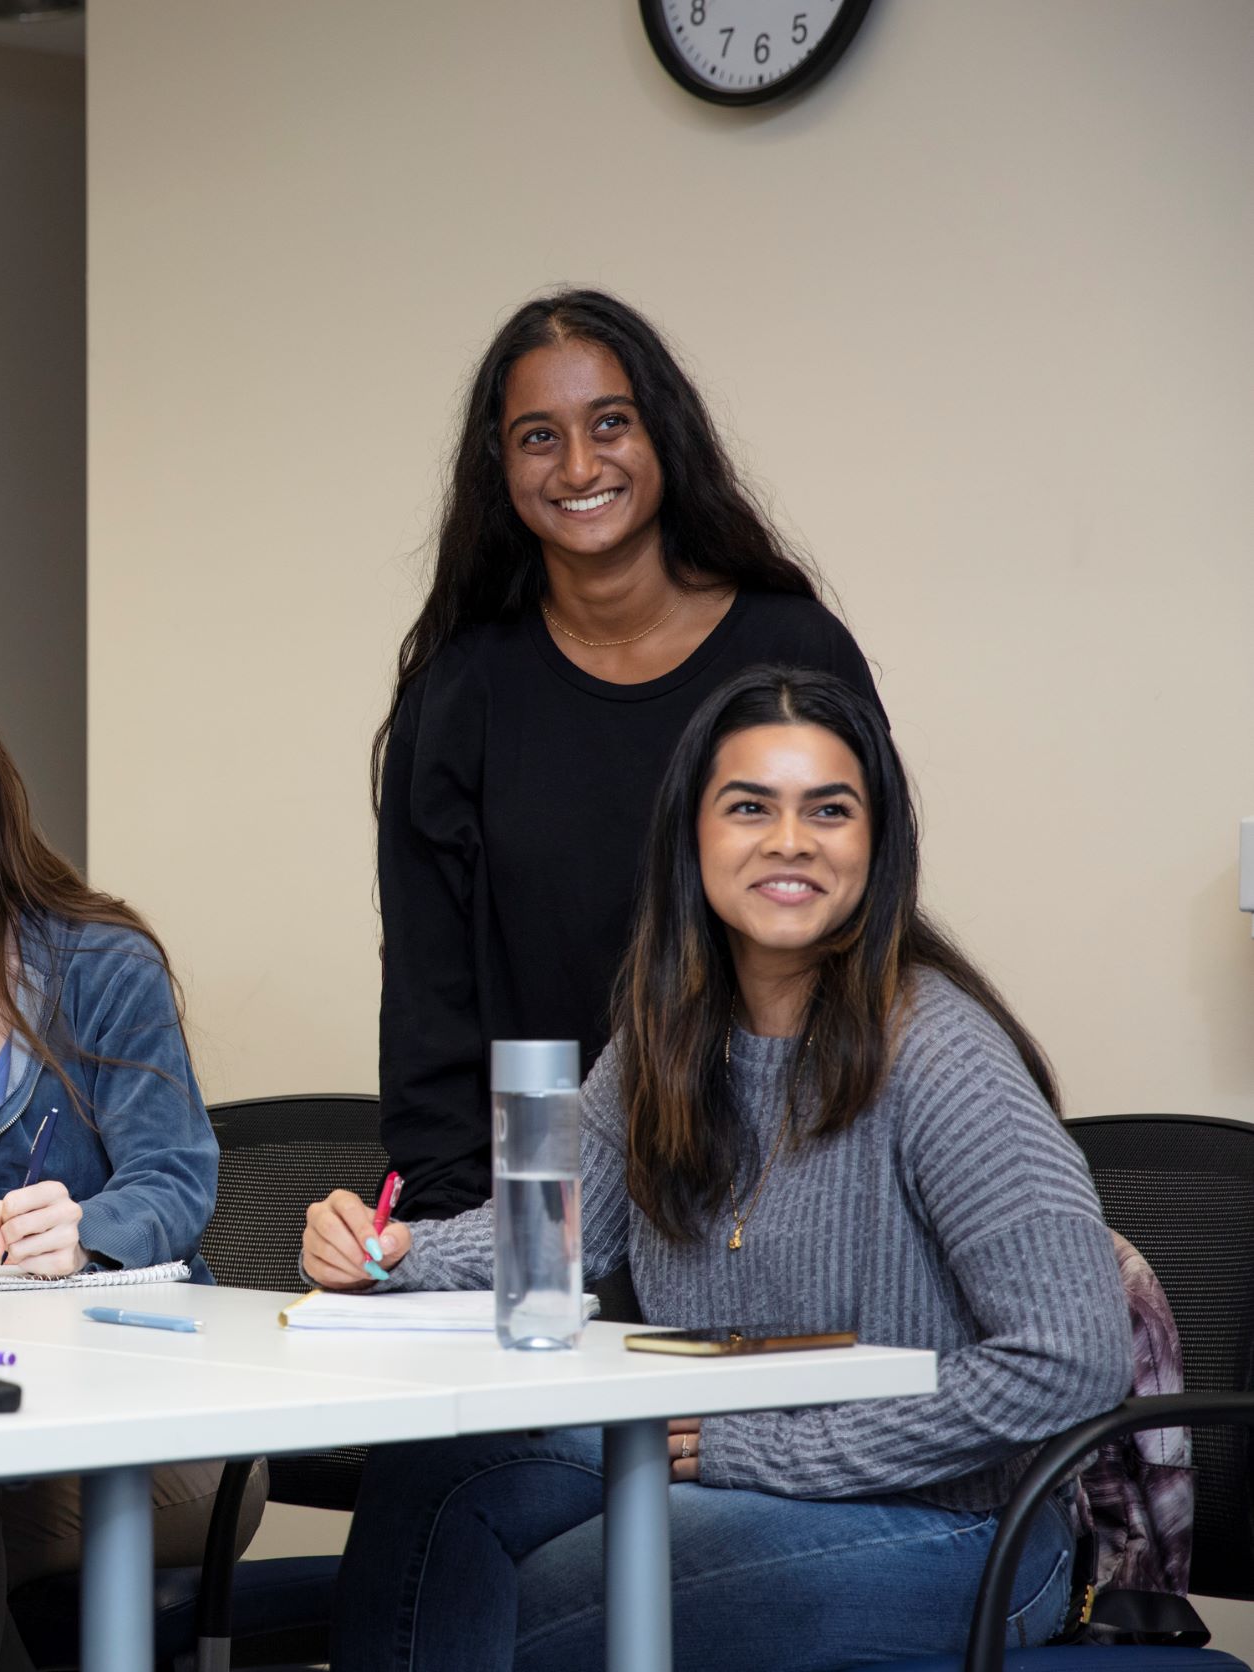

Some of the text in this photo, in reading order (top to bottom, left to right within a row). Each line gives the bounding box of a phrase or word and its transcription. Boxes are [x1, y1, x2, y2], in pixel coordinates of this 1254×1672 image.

[690, 0, 706, 26] 8
[792, 13, 808, 44] 5
[719, 27, 735, 58] 7
[754, 33, 770, 64] 6
